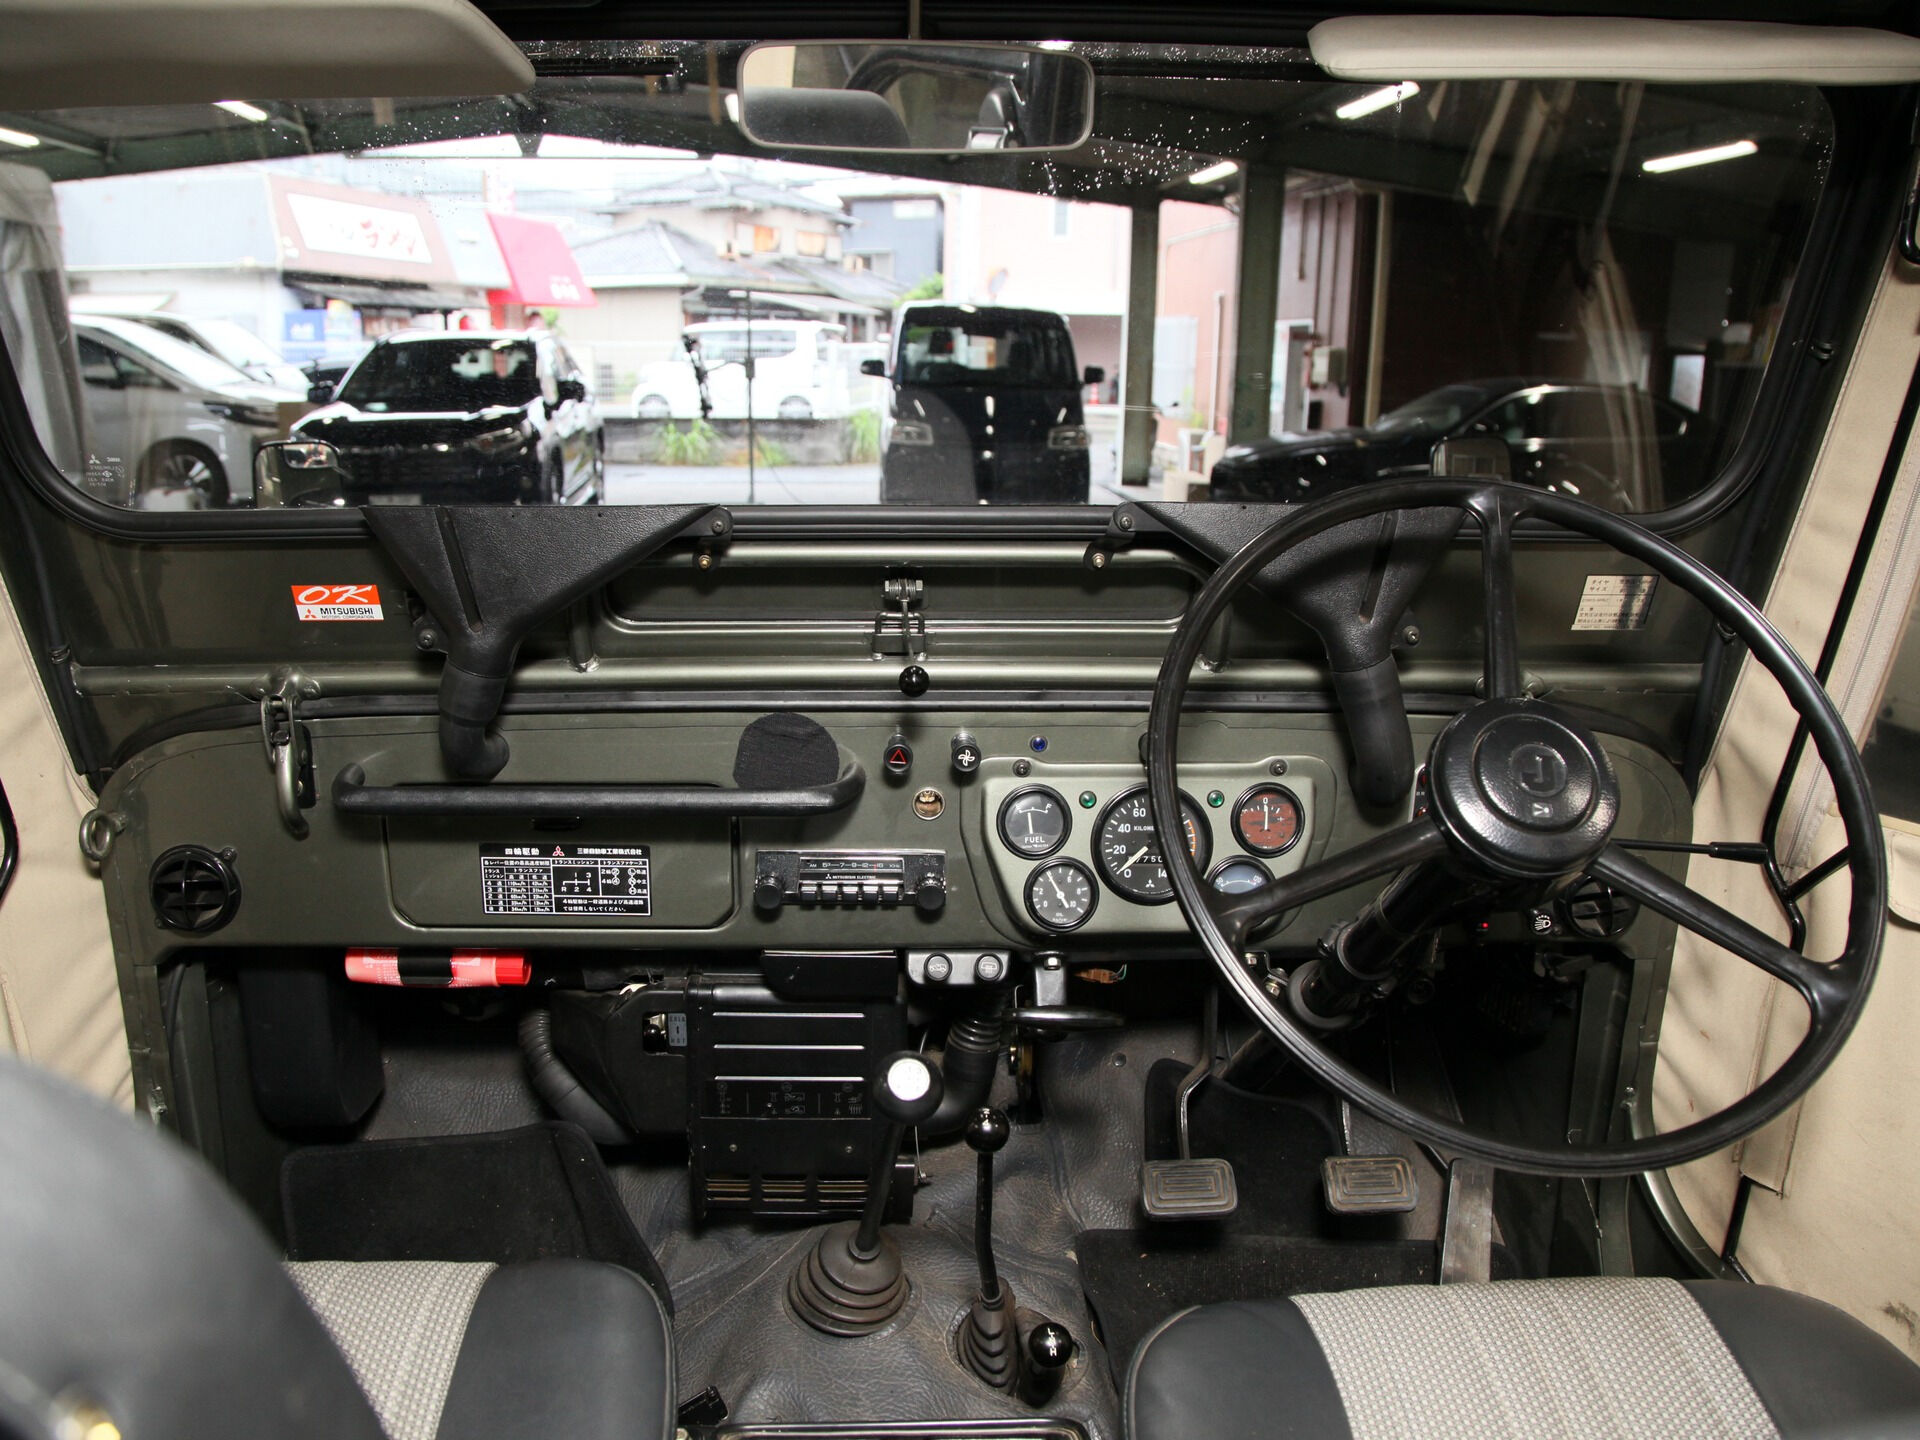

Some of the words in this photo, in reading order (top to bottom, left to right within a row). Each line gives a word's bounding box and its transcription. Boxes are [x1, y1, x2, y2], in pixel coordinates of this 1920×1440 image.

[298, 586, 373, 604] OK
[320, 607, 374, 615] MITSUBISHI
[1133, 808, 1146, 817] 60
[1118, 824, 1131, 833] 40
[1113, 845, 1126, 854] 20
[1124, 869, 1132, 878] 0
[1158, 868, 1168, 878] 14
[1050, 1347, 1057, 1356] H
